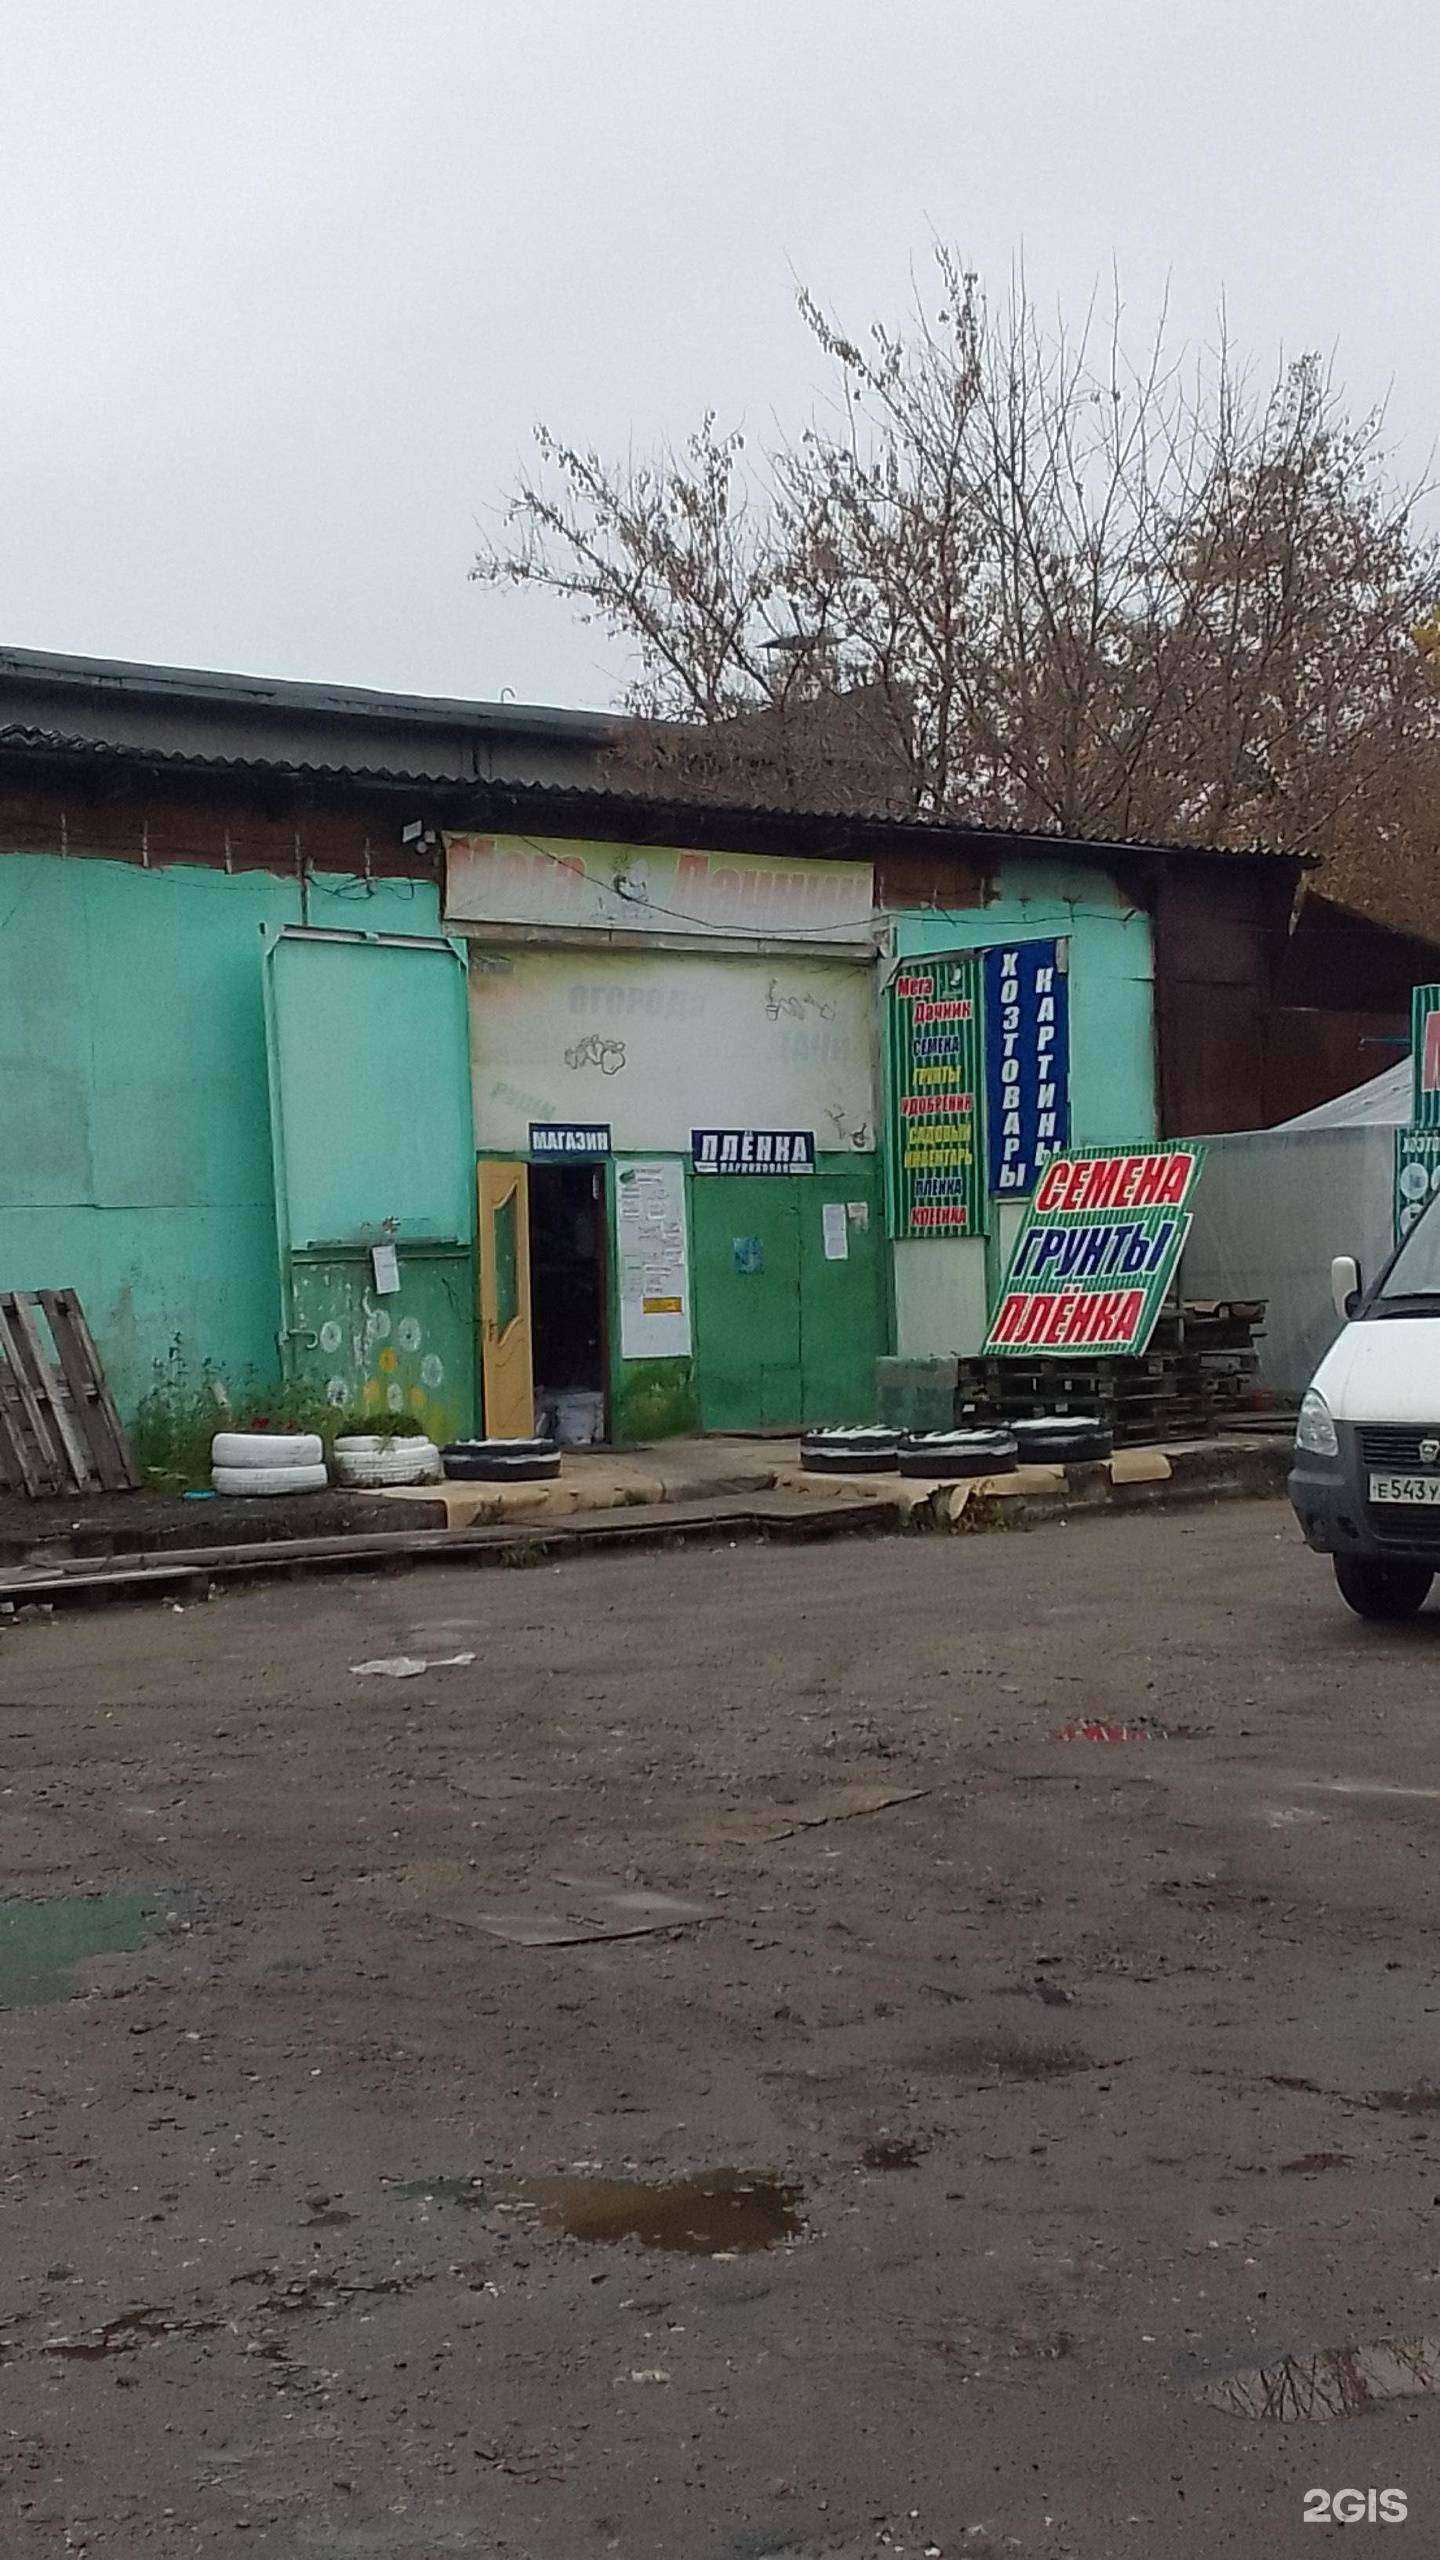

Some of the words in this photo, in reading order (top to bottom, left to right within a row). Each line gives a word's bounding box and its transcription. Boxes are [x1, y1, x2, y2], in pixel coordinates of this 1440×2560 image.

[897, 976, 934, 997] Мега
[912, 1000, 973, 1024] Дачник
[912, 1035, 960, 1056] СЕМЕНА
[912, 1066, 961, 1085] ГРУНТЫ
[1000, 952, 1026, 1187] ХОЗТОВАРЫ
[1035, 967, 1062, 1167] КАРТИНЫ
[532, 1131, 610, 1151] МАГАЗИН
[701, 1129, 808, 1161] ПЛЁНКА
[1036, 1153, 1195, 1213] СЕМЕНА
[1010, 1221, 1177, 1279] ГРУНТЫ
[987, 1284, 1147, 1345] ПЛЁНКА
